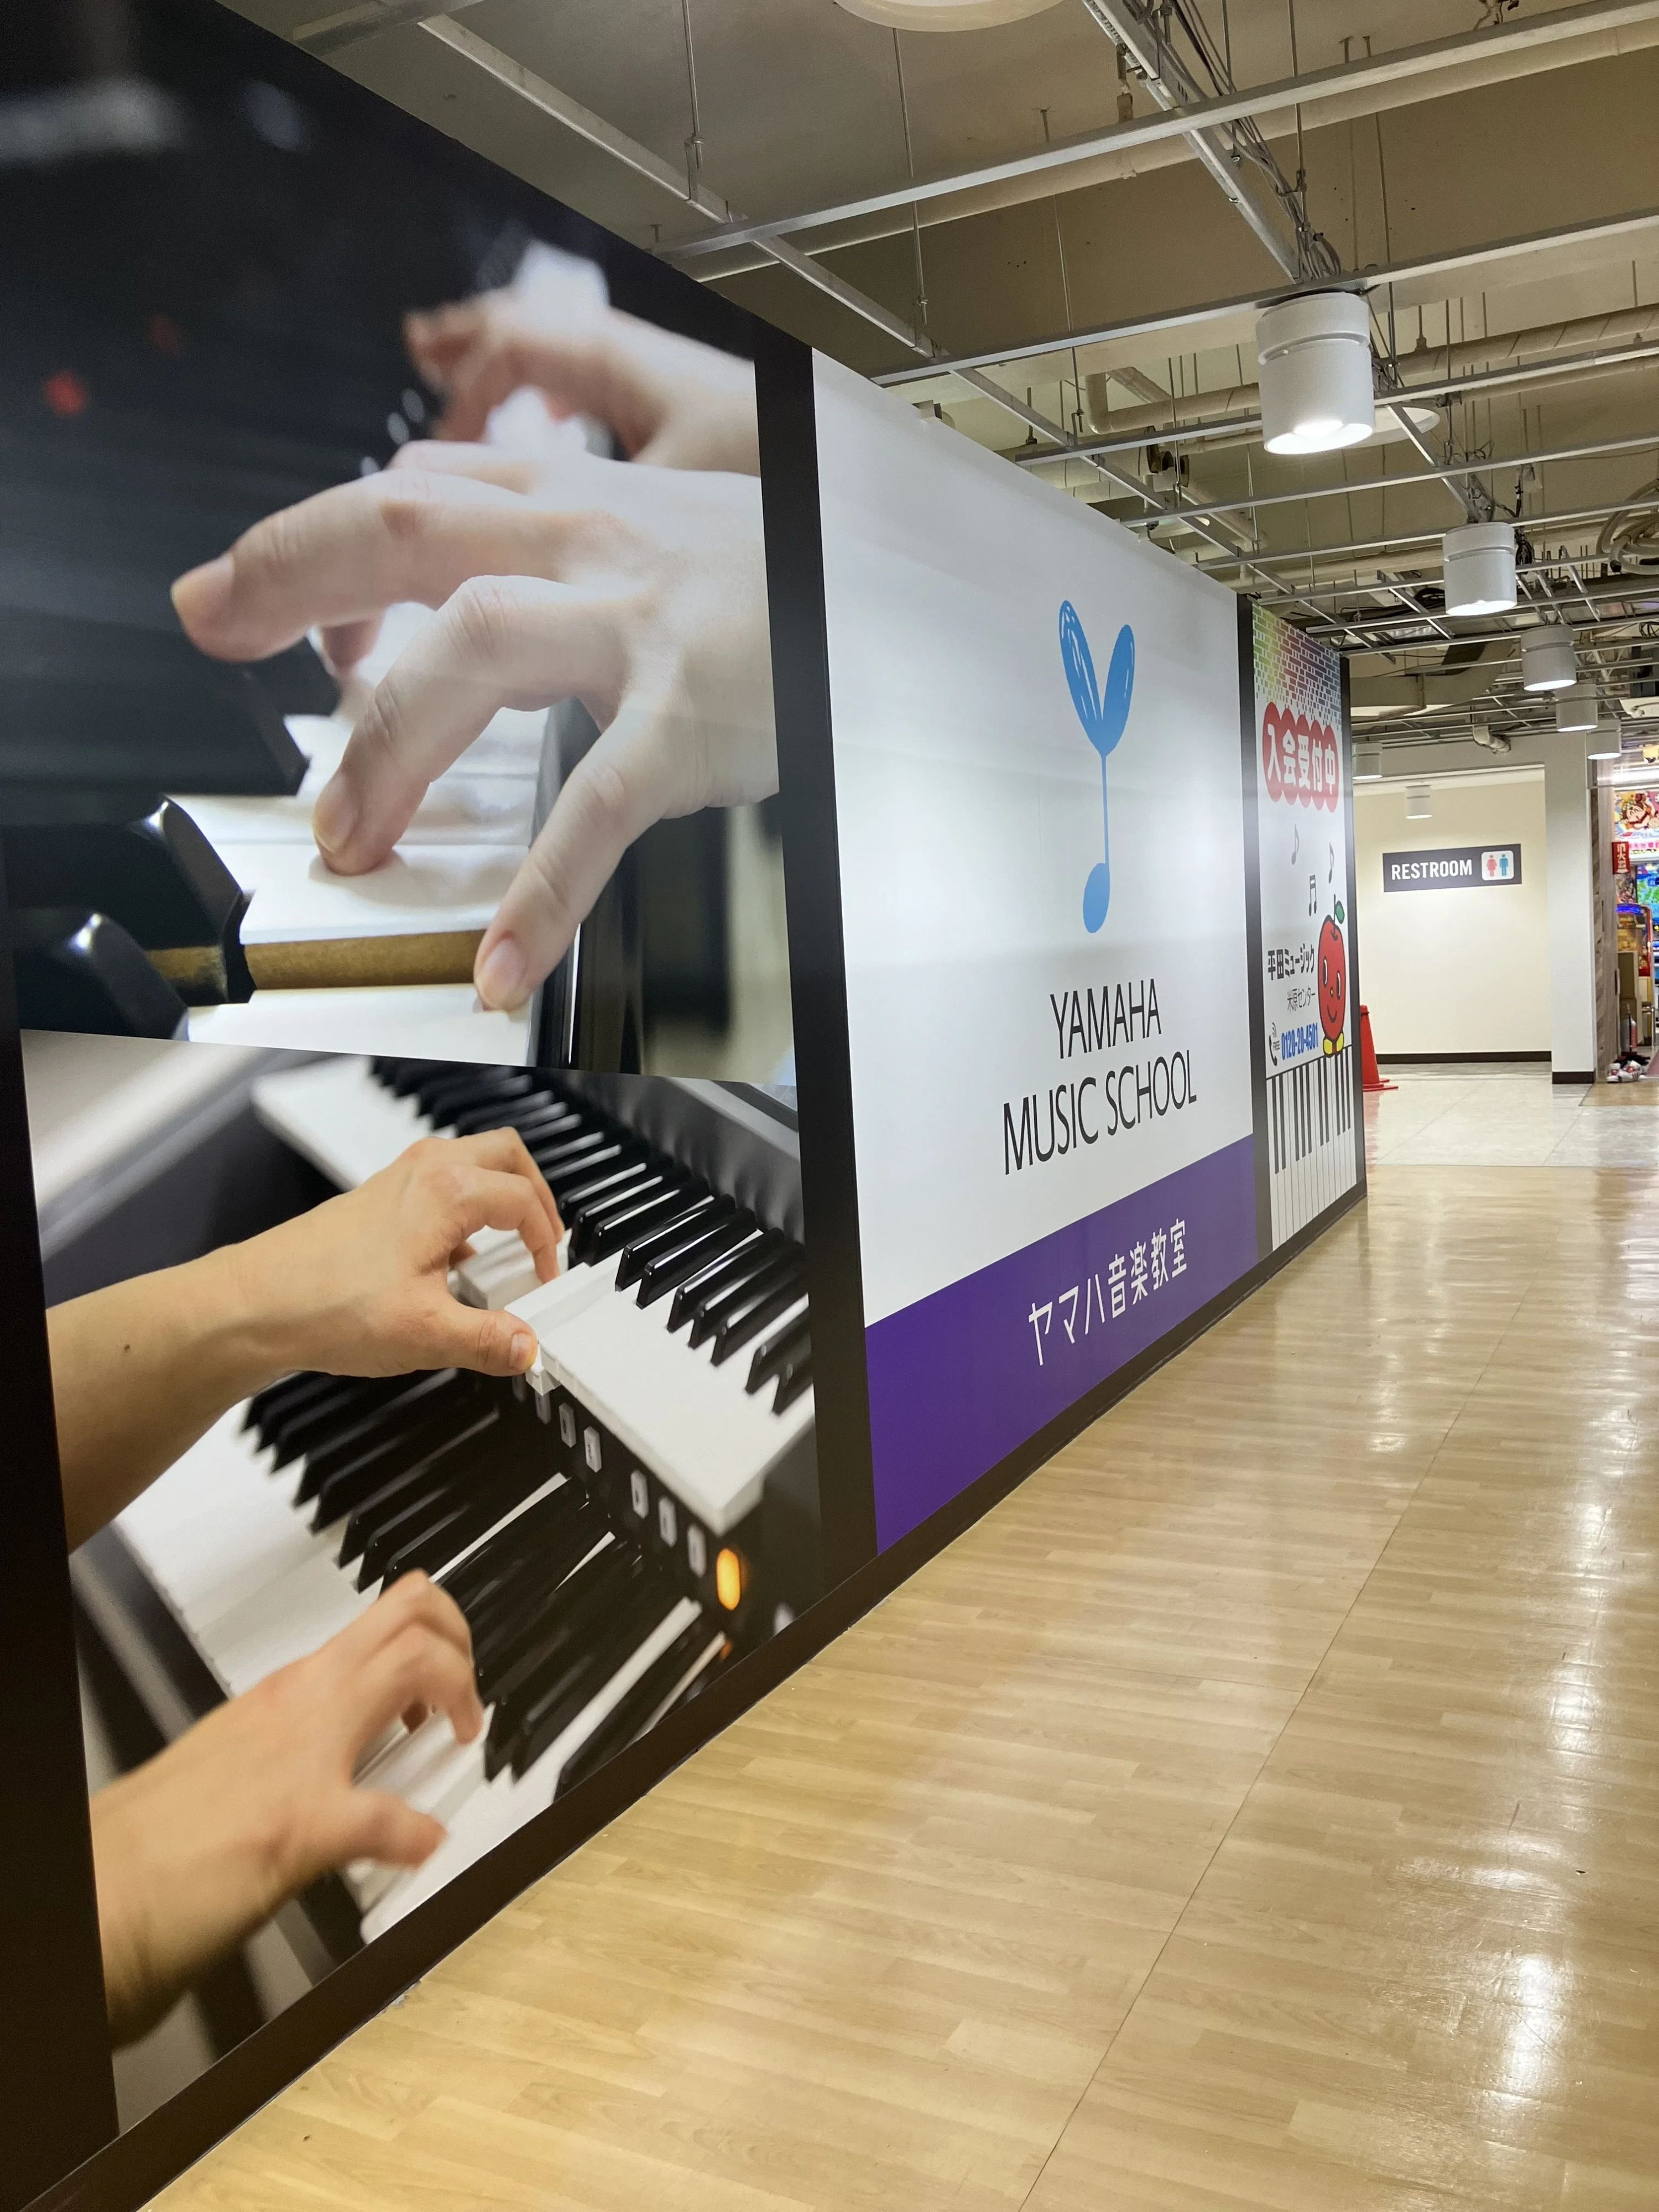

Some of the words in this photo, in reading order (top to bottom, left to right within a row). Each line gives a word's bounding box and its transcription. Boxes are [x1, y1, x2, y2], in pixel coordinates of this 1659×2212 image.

[1267, 723, 1336, 795] 入会受付中
[1391, 859, 1473, 880] RESTROOM
[1267, 943, 1314, 980] 平田ミュージック
[1050, 978, 1161, 1059] YAMAHA
[1287, 986, 1316, 1013] 米原センター
[1281, 1022, 1318, 1061] 0120-20-4501
[1003, 1076, 1099, 1176] MUSIC
[1105, 1050, 1197, 1136] SCHOOL
[1029, 1218, 1187, 1366] ヤマハ音楽教室
